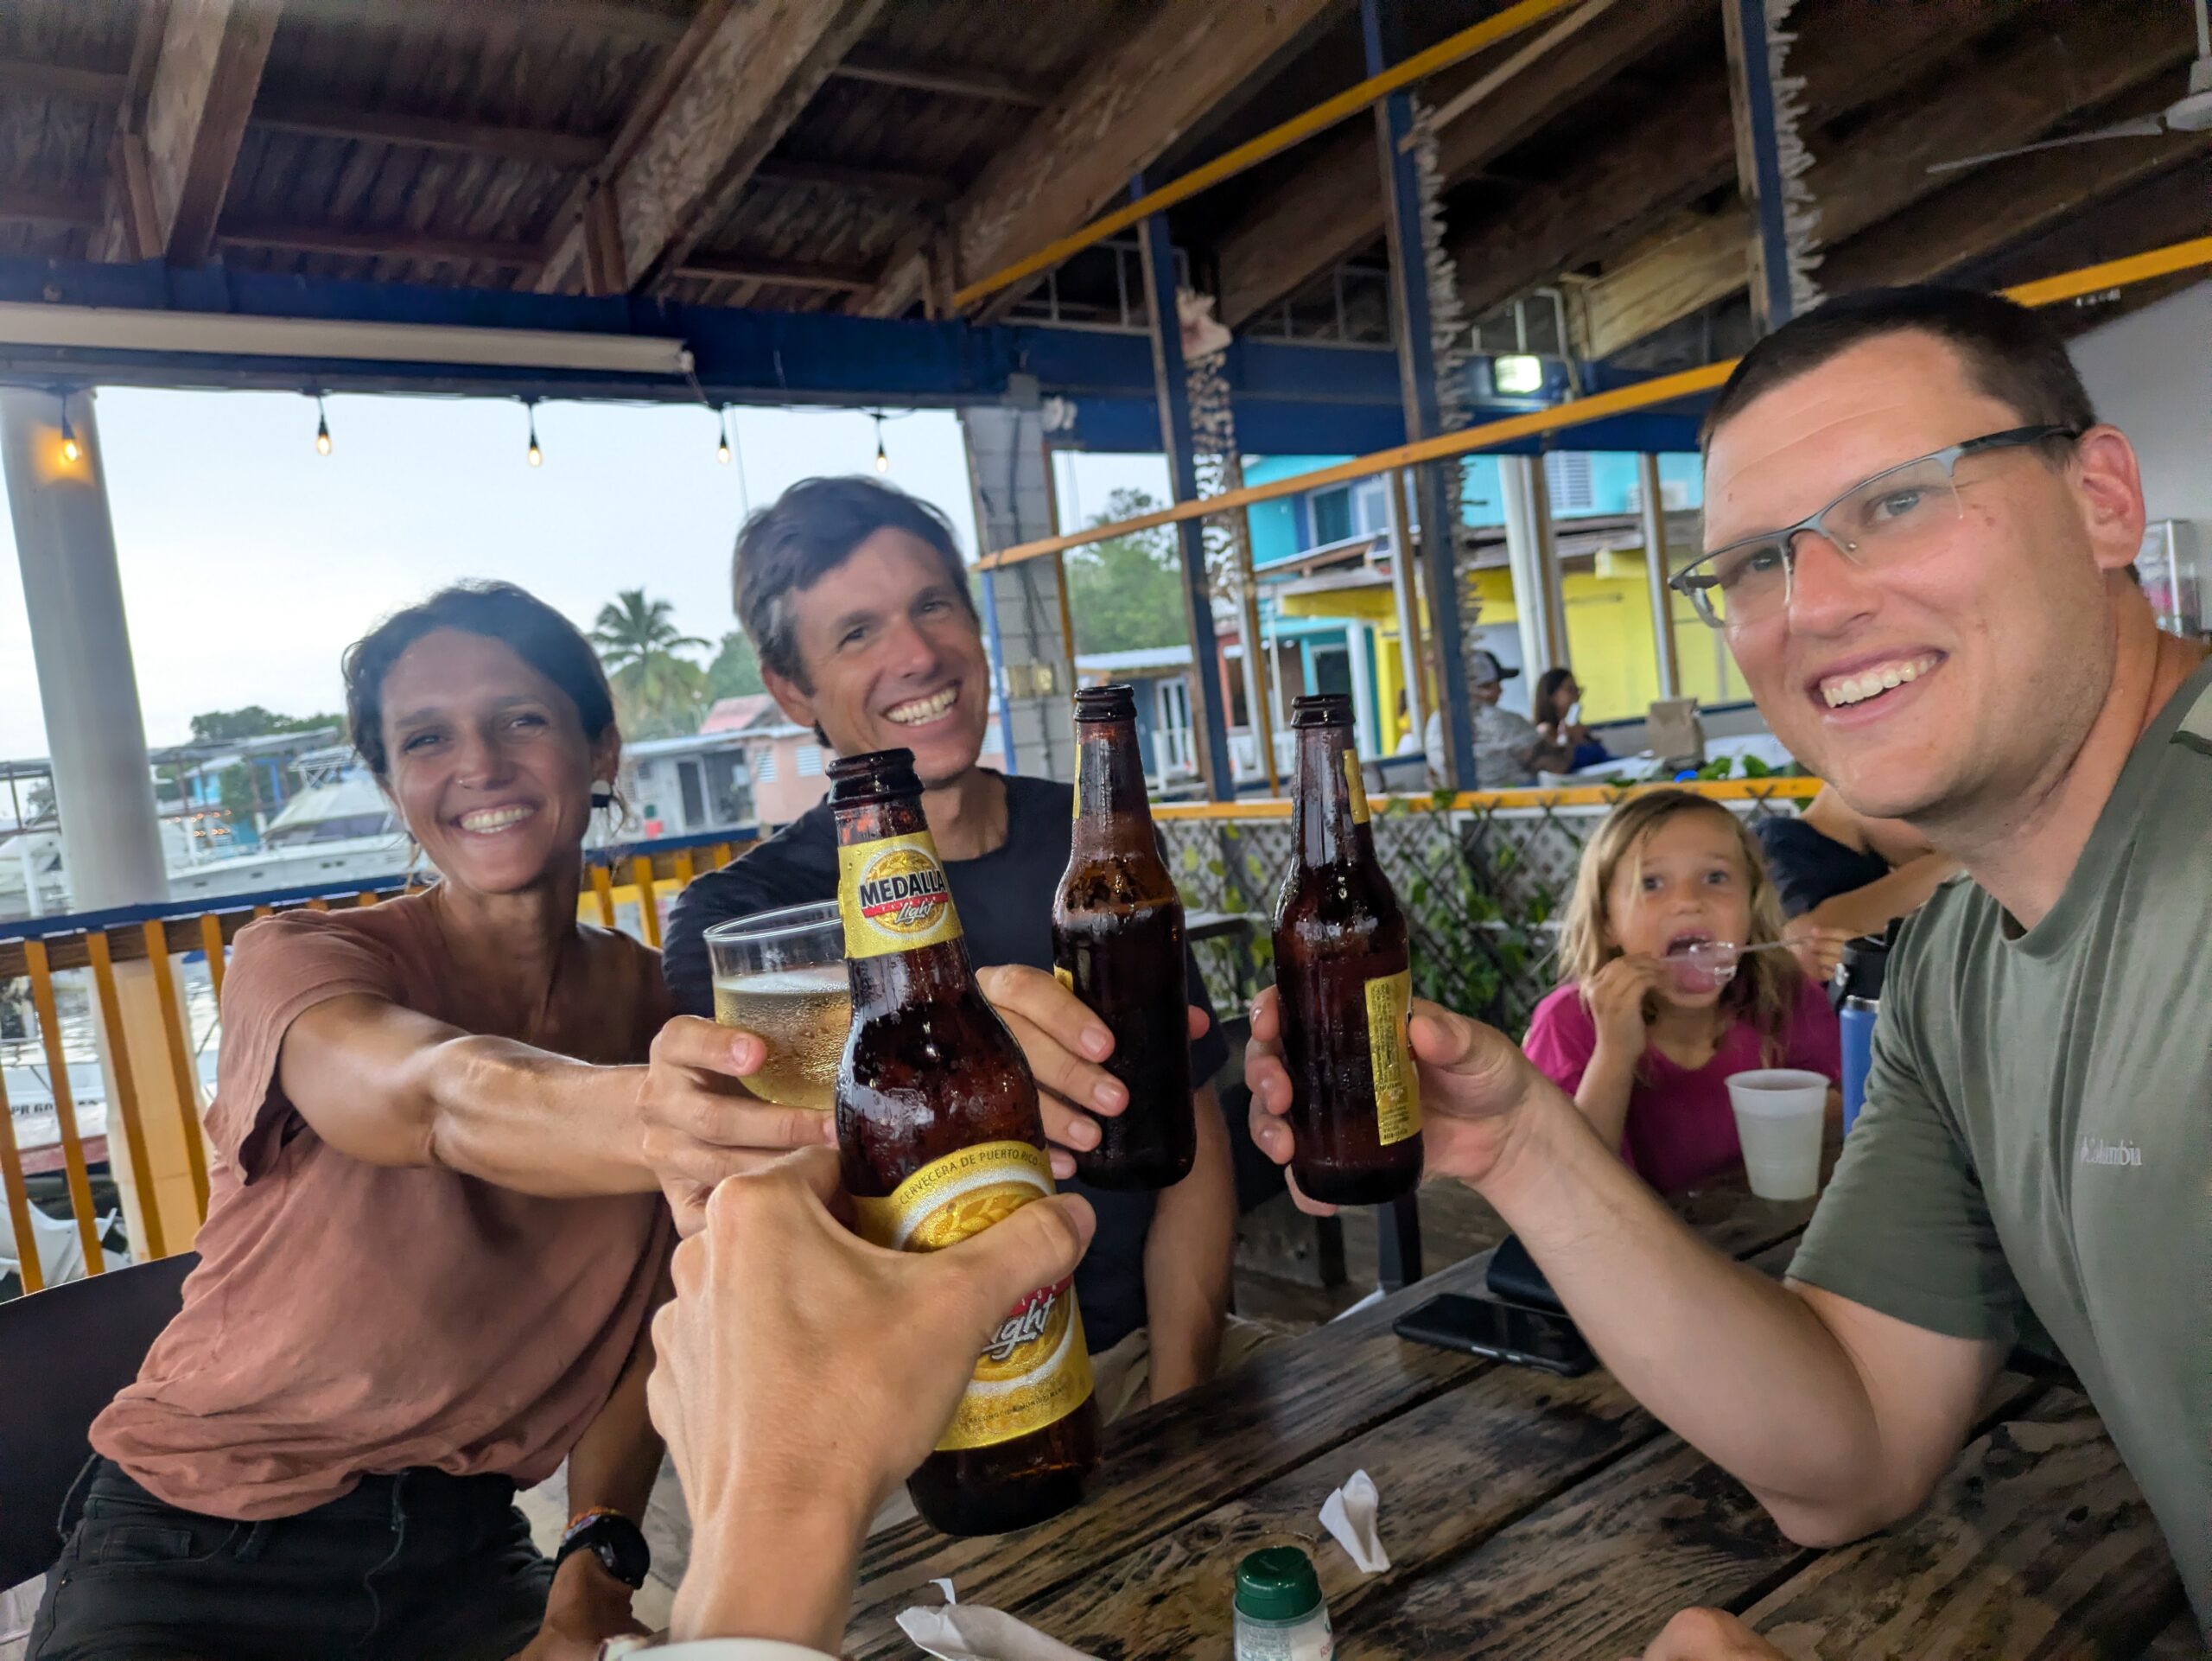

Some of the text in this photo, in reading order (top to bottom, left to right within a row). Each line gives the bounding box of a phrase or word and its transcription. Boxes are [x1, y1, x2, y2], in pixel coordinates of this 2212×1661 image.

[859, 869, 946, 908] MEDALLA
[893, 900, 935, 924] Light
[899, 1162, 957, 1205] CERVECERA
[960, 1155, 976, 1168] DE
[979, 1149, 1019, 1162] PUERTO
[982, 1293, 1055, 1360] ight
